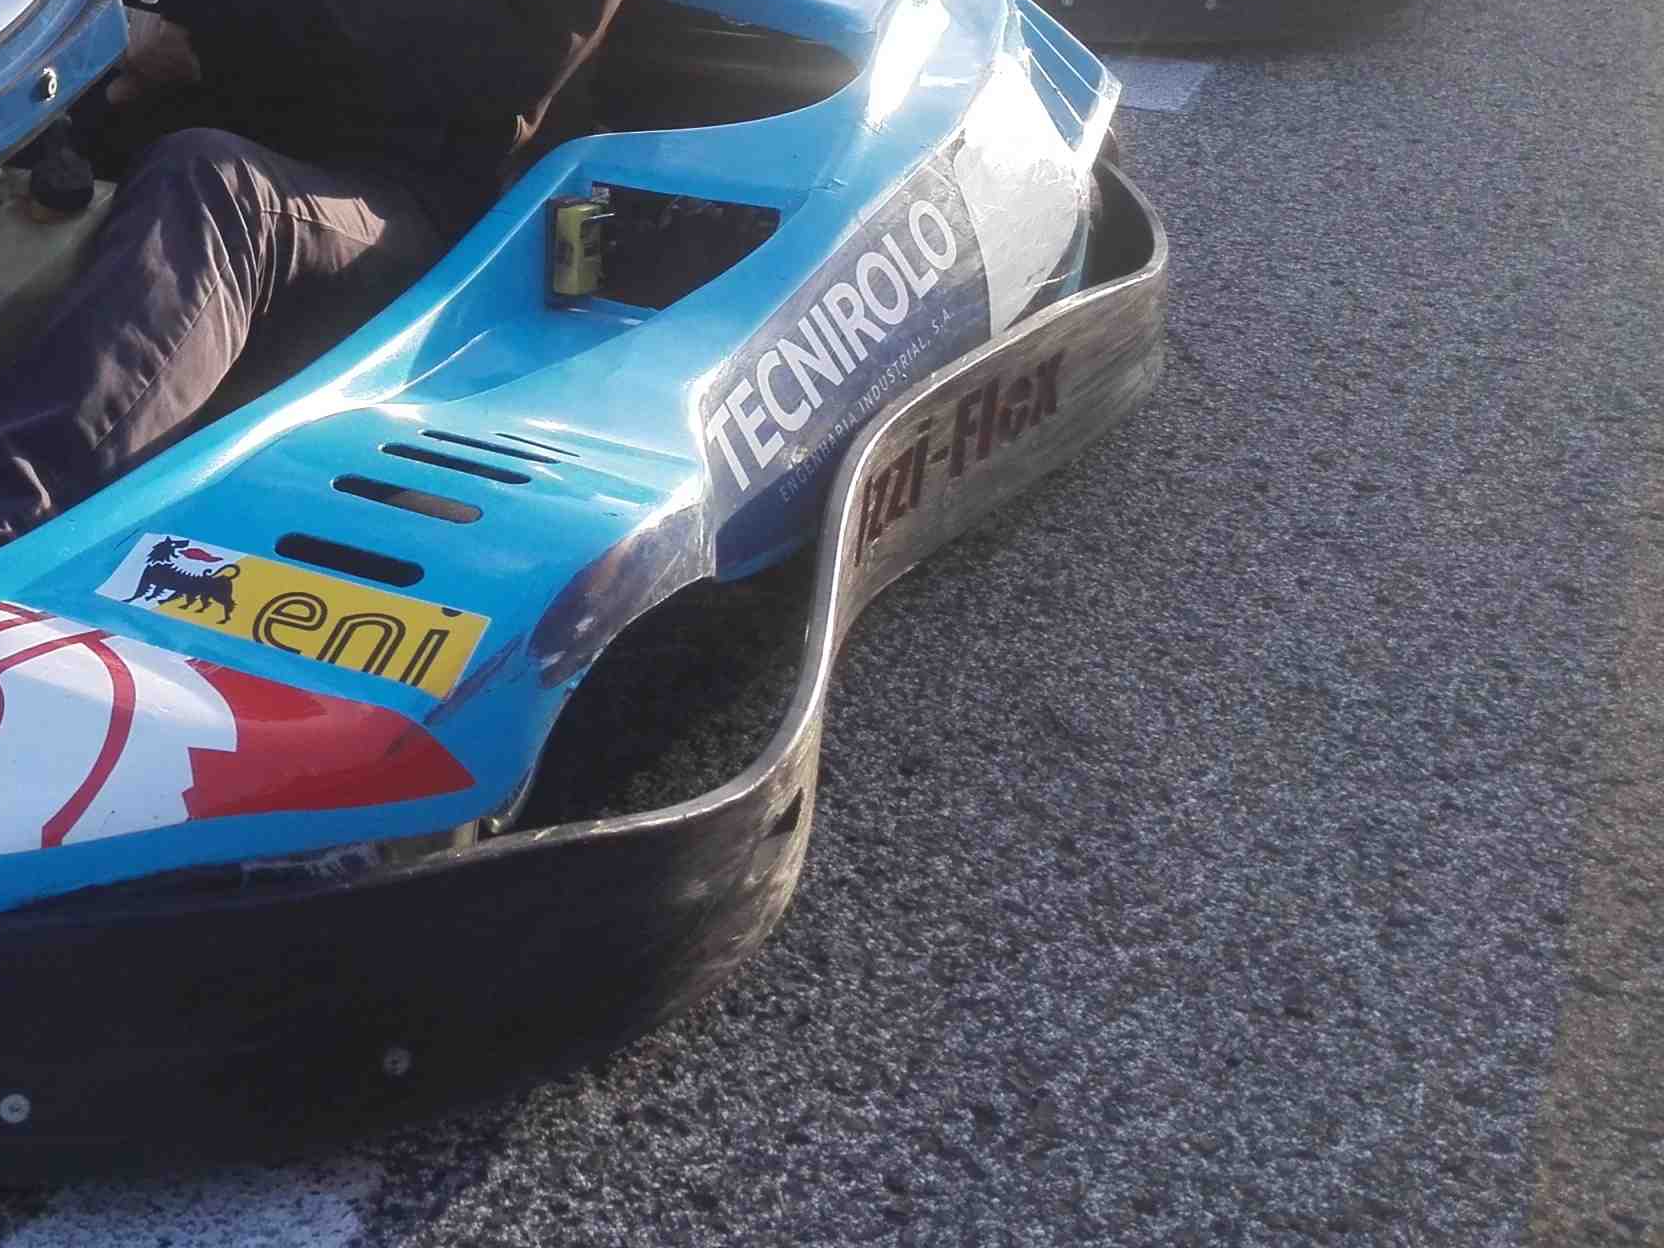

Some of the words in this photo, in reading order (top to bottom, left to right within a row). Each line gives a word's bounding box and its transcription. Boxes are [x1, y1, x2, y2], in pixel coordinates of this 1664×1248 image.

[705, 199, 959, 492] TECNIROLO
[778, 411, 859, 503] ENGENHARIA
[930, 307, 955, 334] S.A.
[252, 590, 464, 688] eni
